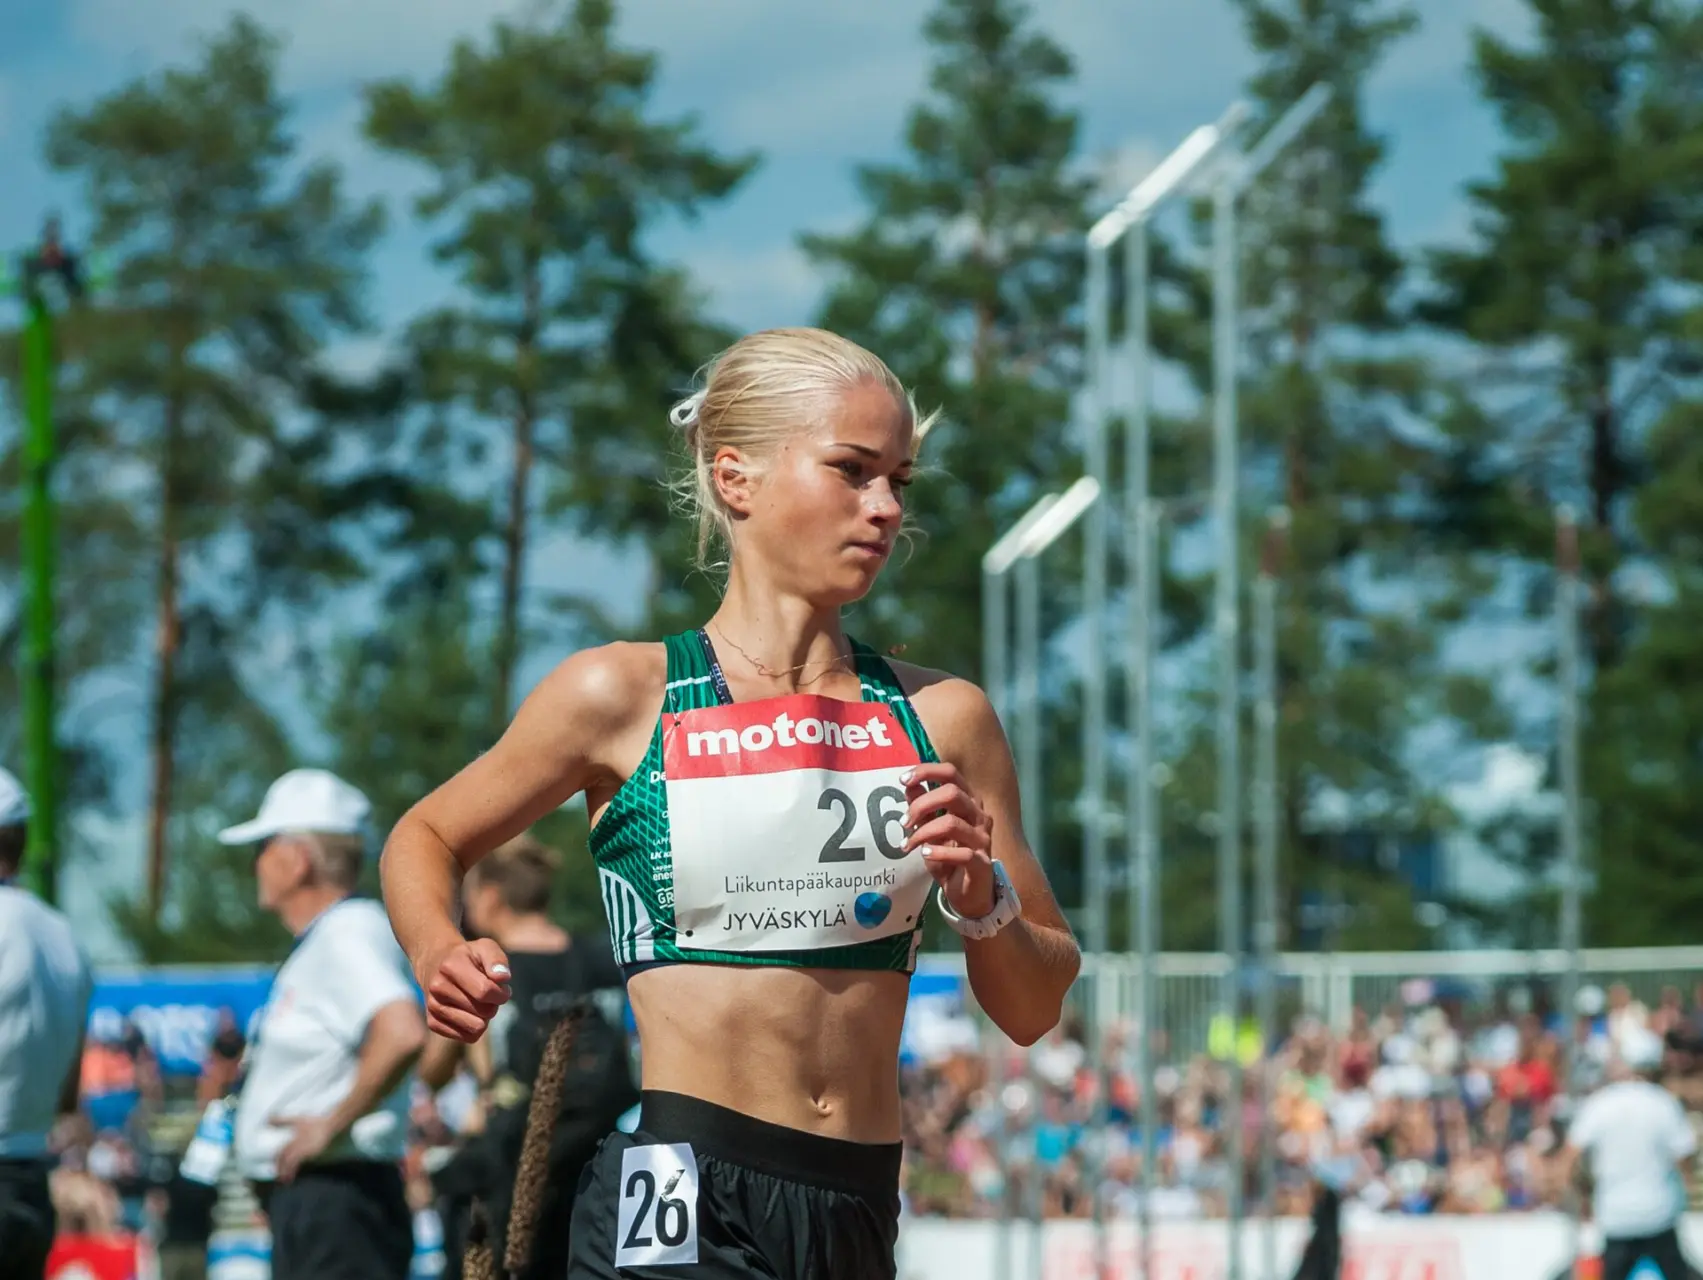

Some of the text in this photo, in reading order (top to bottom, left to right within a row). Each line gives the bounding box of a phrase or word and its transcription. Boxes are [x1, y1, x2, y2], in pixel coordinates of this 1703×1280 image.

[687, 712, 892, 757] motonet
[817, 785, 915, 863] 26
[725, 868, 895, 896] Liikuntapääkaupunki
[723, 904, 847, 931] JYVÄSKYLÄ
[621, 1168, 689, 1249] 26
